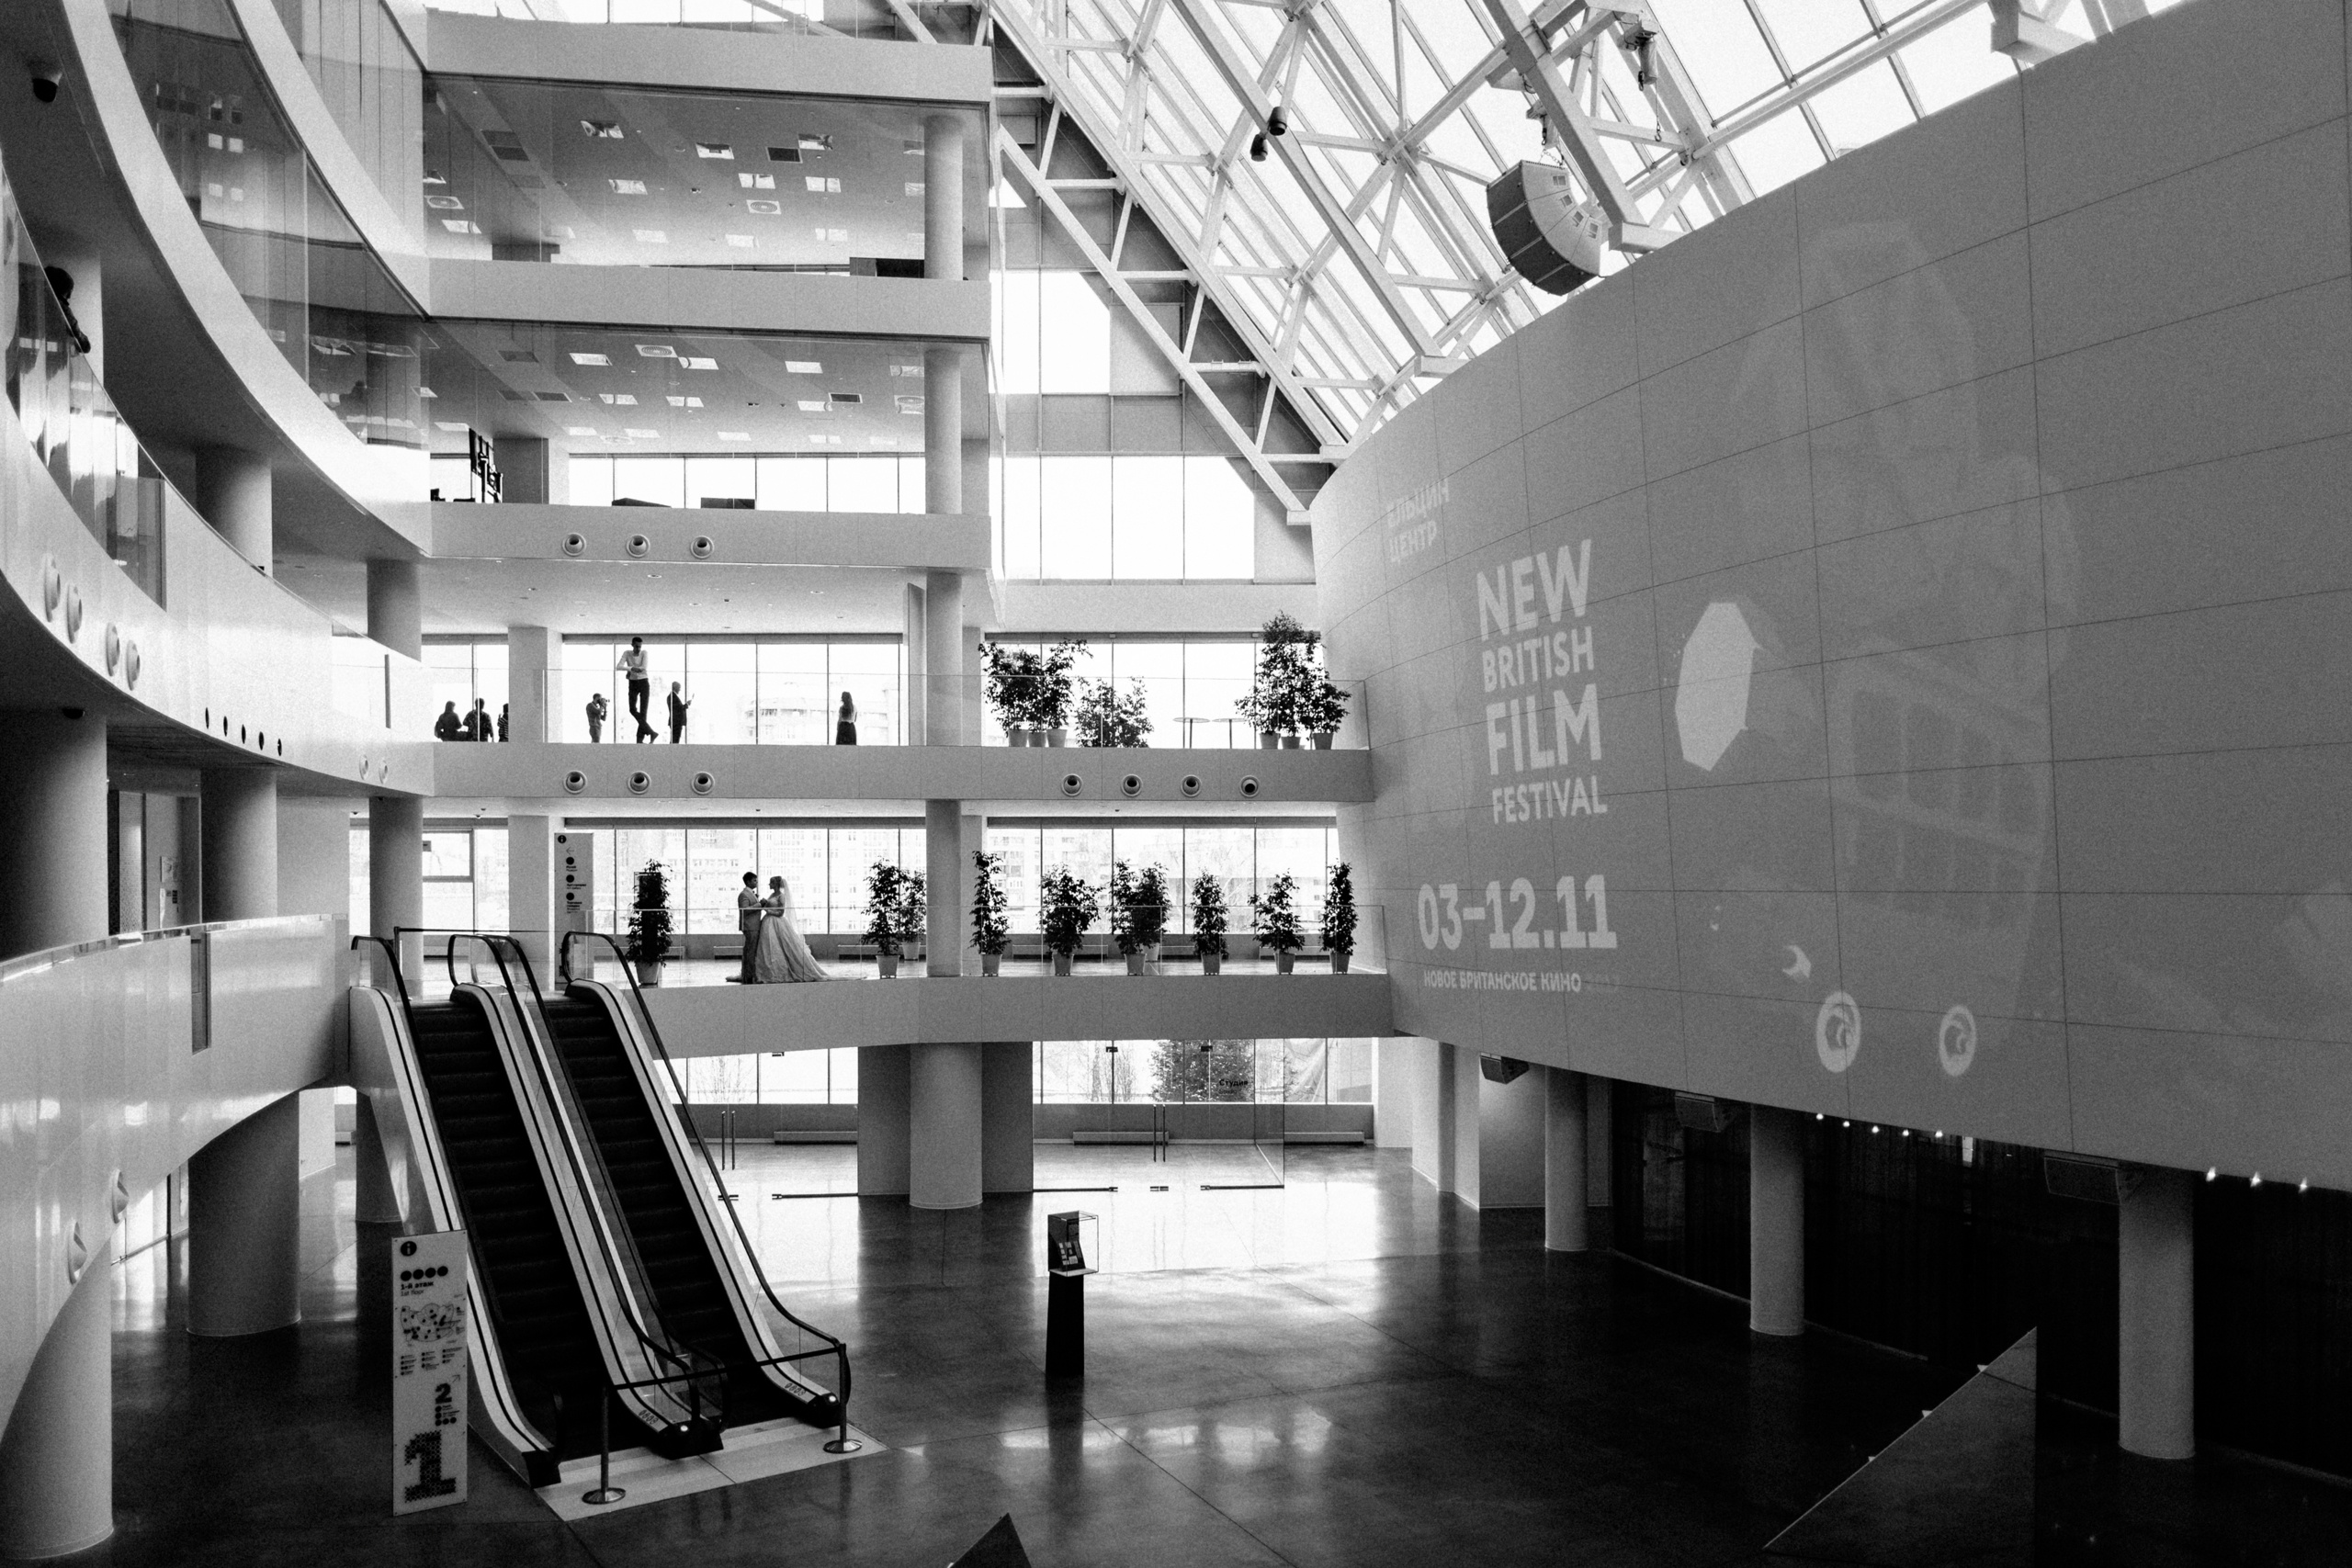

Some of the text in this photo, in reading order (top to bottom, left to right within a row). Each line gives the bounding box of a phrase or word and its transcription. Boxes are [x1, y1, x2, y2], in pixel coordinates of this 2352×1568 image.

[1388, 520, 1437, 565] ЦЕНТР
[1476, 538, 1592, 642] NEW
[1482, 626, 1595, 693] BRITISH
[1486, 682, 1602, 775] FILM
[1492, 775, 1608, 825] FESTIVAL
[1418, 874, 1617, 951] 03-12.11
[1424, 970, 1457, 989] НОВОЕ
[1459, 971, 1537, 991] БРИТАНСКОЕ
[1541, 972, 1581, 993] КИНО
[1219, 1078, 1249, 1088] Студия
[435, 1382, 453, 1404] 2
[404, 1429, 457, 1503] 1
